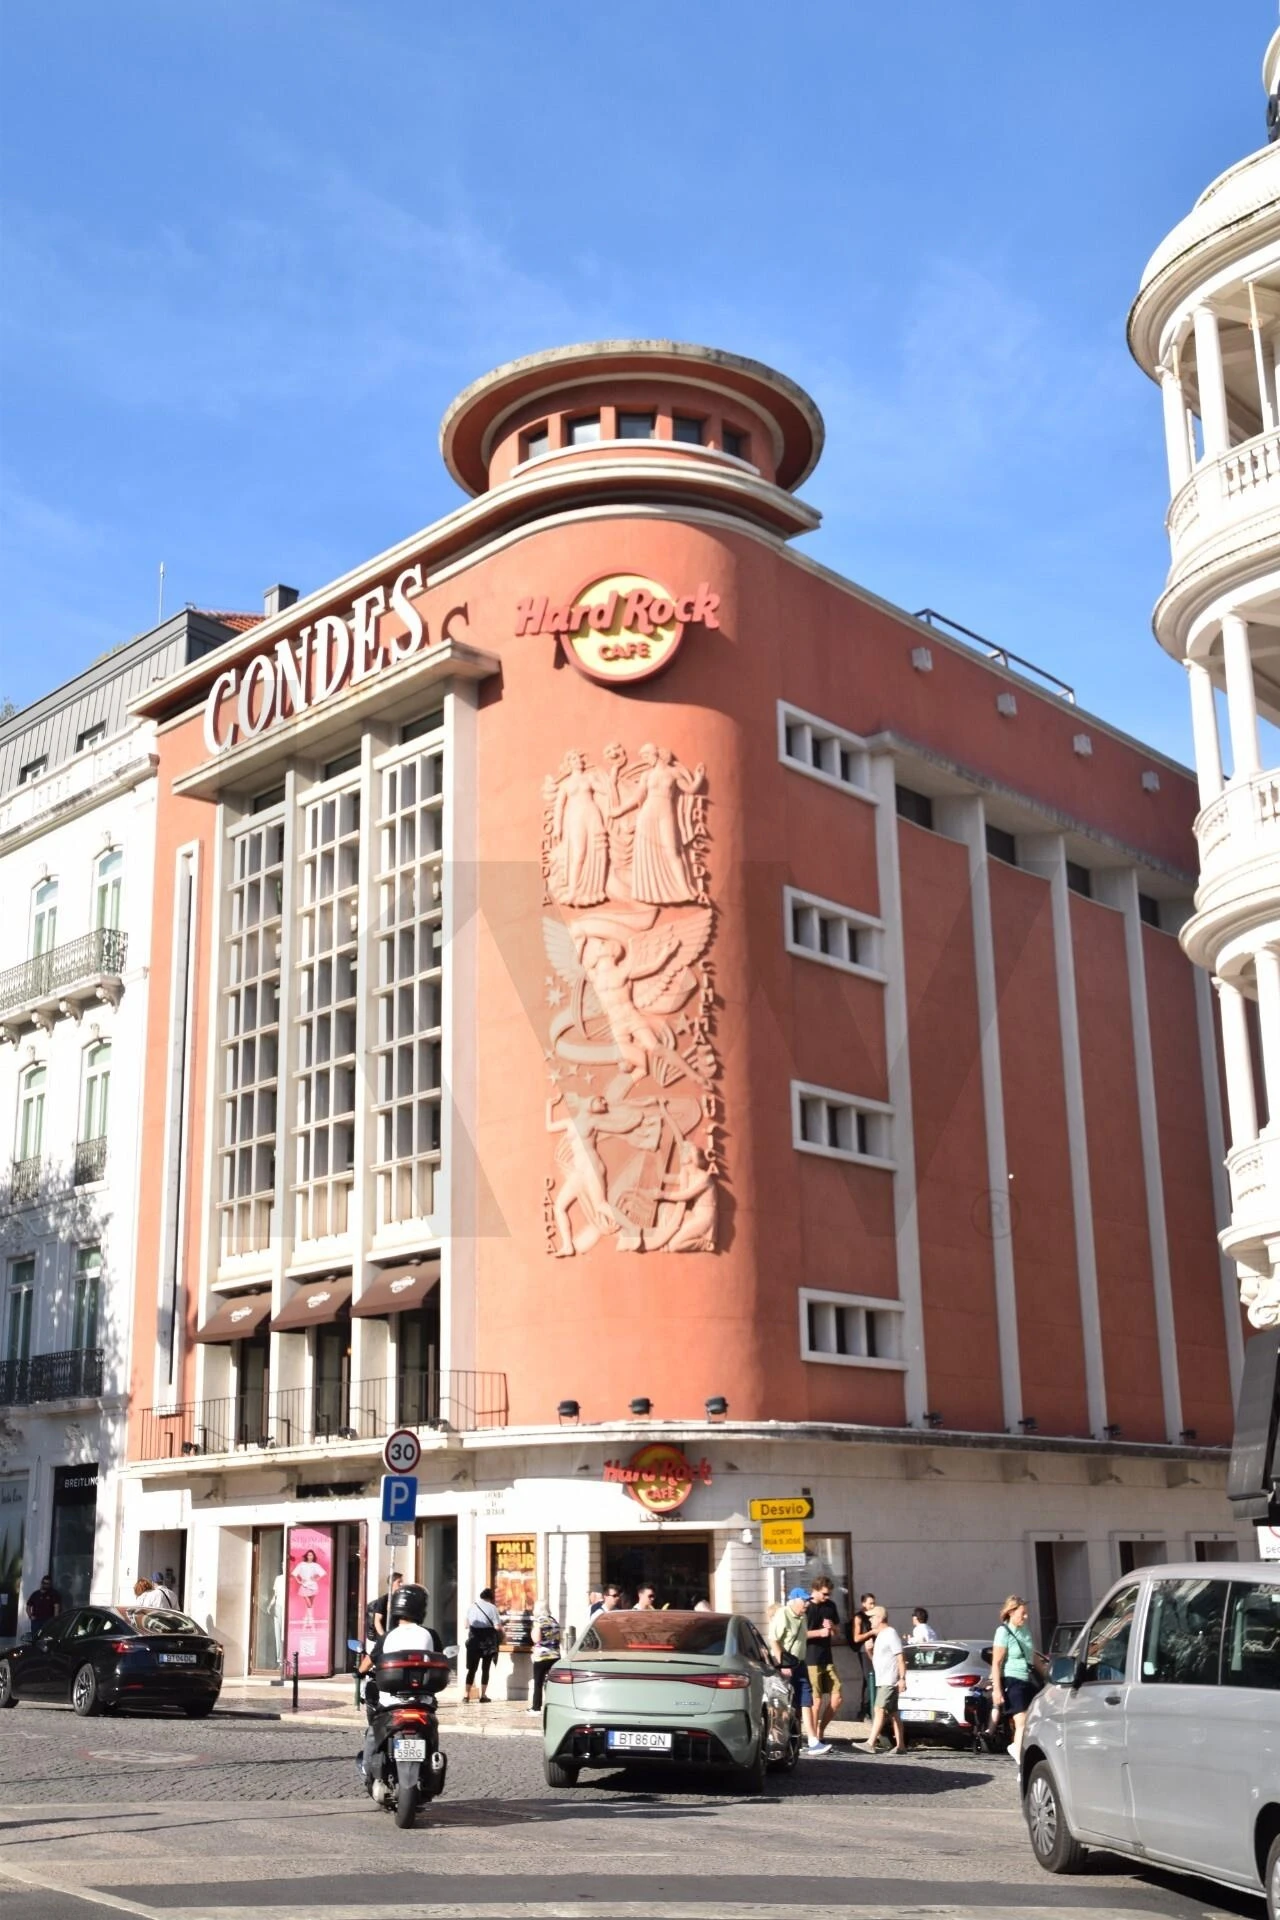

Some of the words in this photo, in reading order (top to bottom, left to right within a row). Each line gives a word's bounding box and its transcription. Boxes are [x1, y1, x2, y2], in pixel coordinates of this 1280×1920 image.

[515, 589, 620, 637] Hard
[622, 582, 721, 635] Rock
[203, 563, 425, 757] CONDES
[391, 1443, 415, 1461] 30
[602, 1458, 661, 1483] Hard
[660, 1457, 713, 1487] Rock
[390, 1481, 410, 1517] P
[761, 1503, 804, 1516] Desvio
[403, 1740, 417, 1749] BJ
